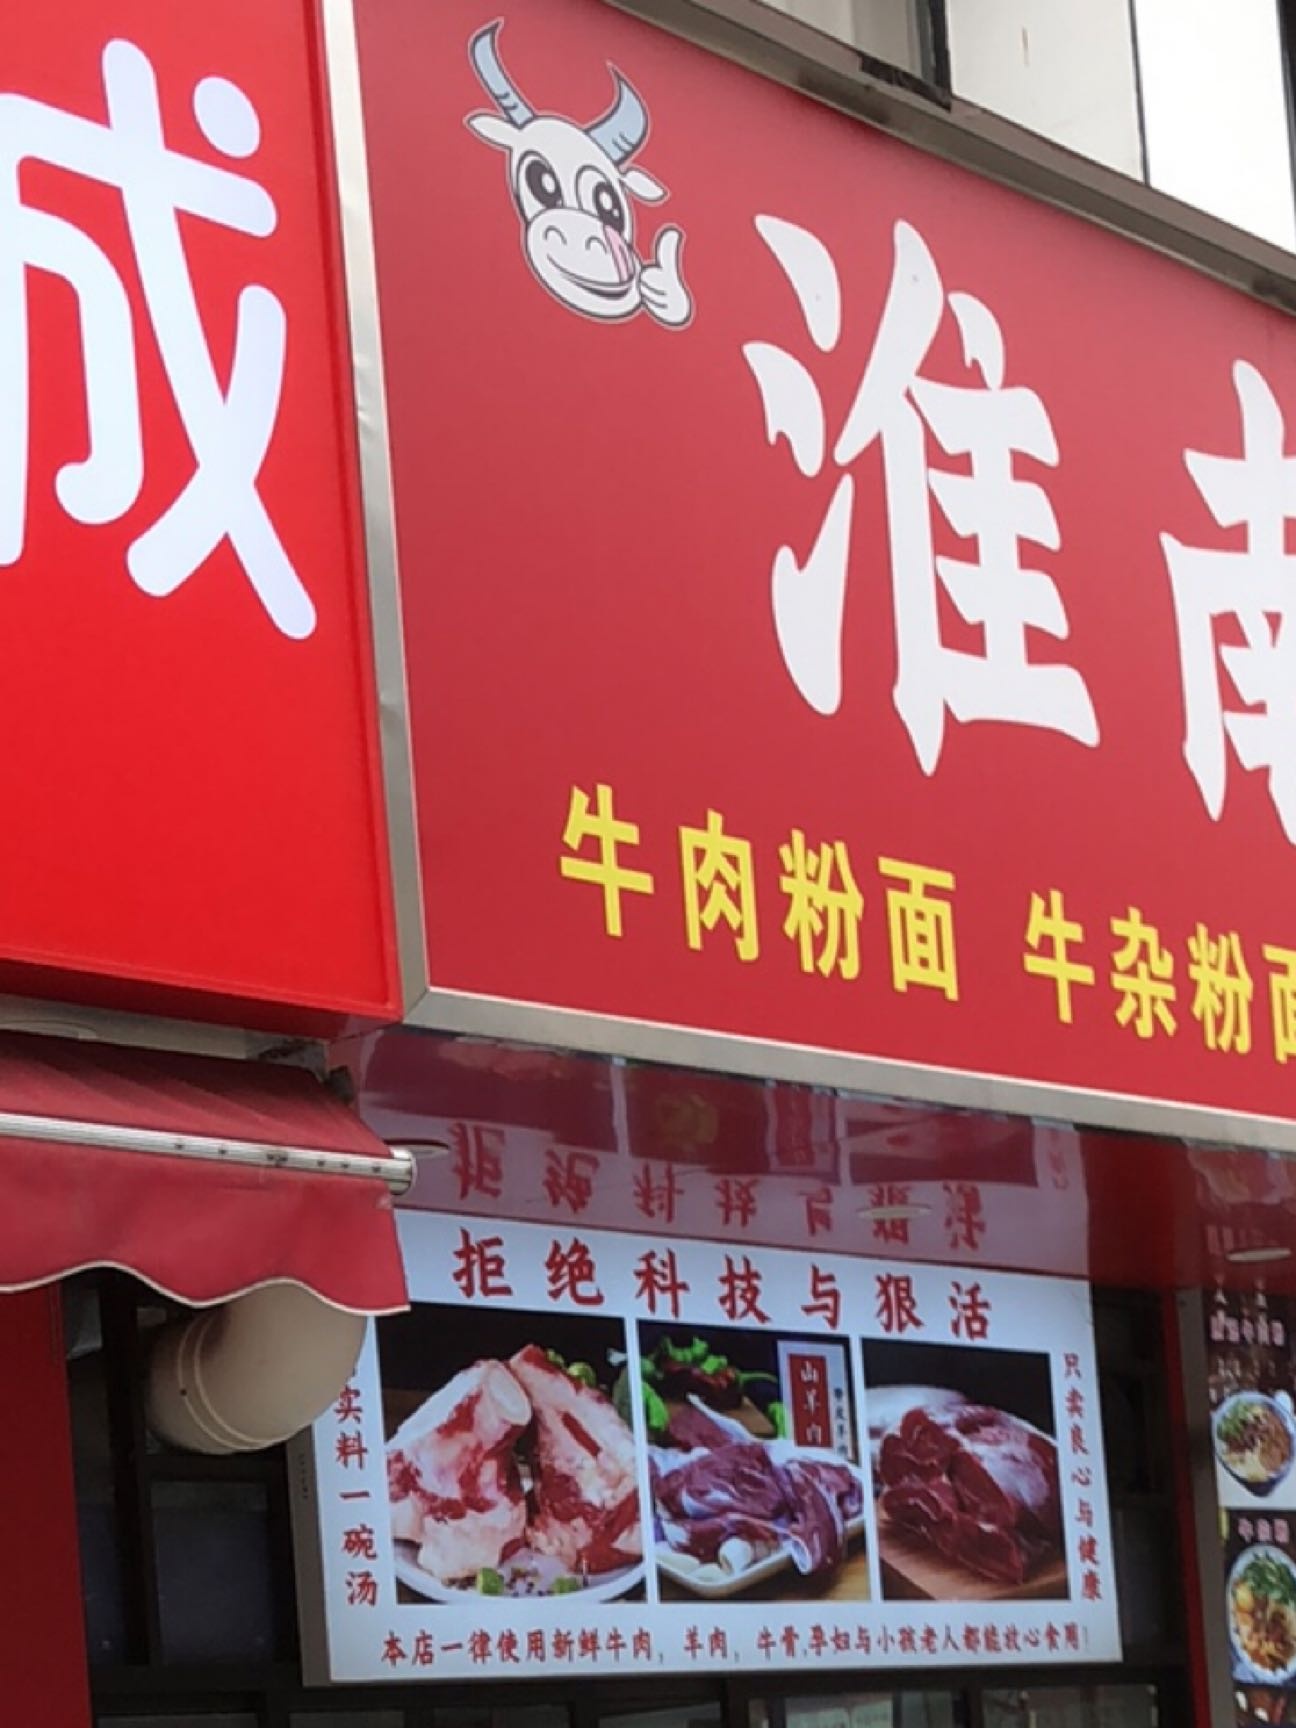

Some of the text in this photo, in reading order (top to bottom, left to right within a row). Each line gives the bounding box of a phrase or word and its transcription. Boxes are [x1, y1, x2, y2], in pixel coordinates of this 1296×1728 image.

[560, 784, 959, 1001] 牛肉粉面
[452, 1228, 992, 1340] 拒绝科技与狠活
[1063, 1351, 1104, 1601] 只卖良心与健康
